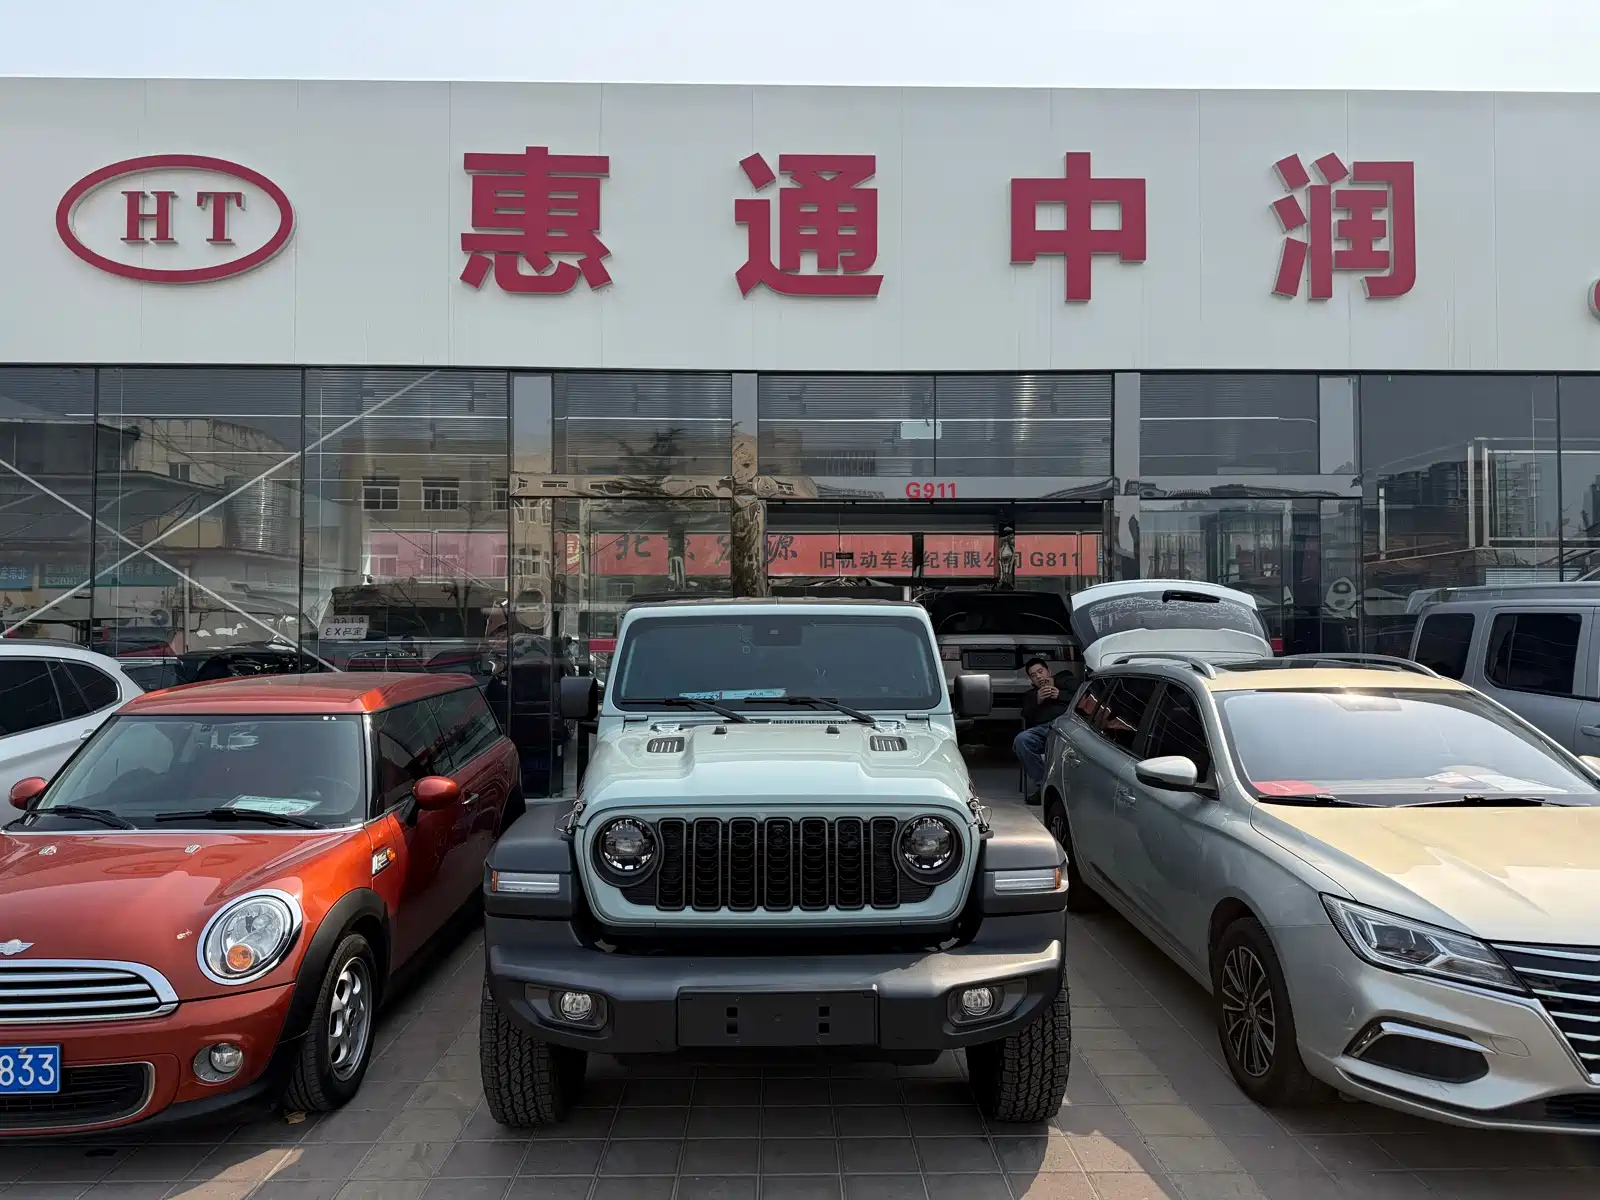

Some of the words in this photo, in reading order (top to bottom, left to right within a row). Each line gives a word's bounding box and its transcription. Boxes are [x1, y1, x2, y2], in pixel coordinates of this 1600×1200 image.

[120, 189, 246, 246] HT
[460, 146, 1417, 303] 惠通中润
[905, 481, 957, 500] G911
[1029, 551, 1080, 567] G811
[0, 1053, 55, 1087] 833
